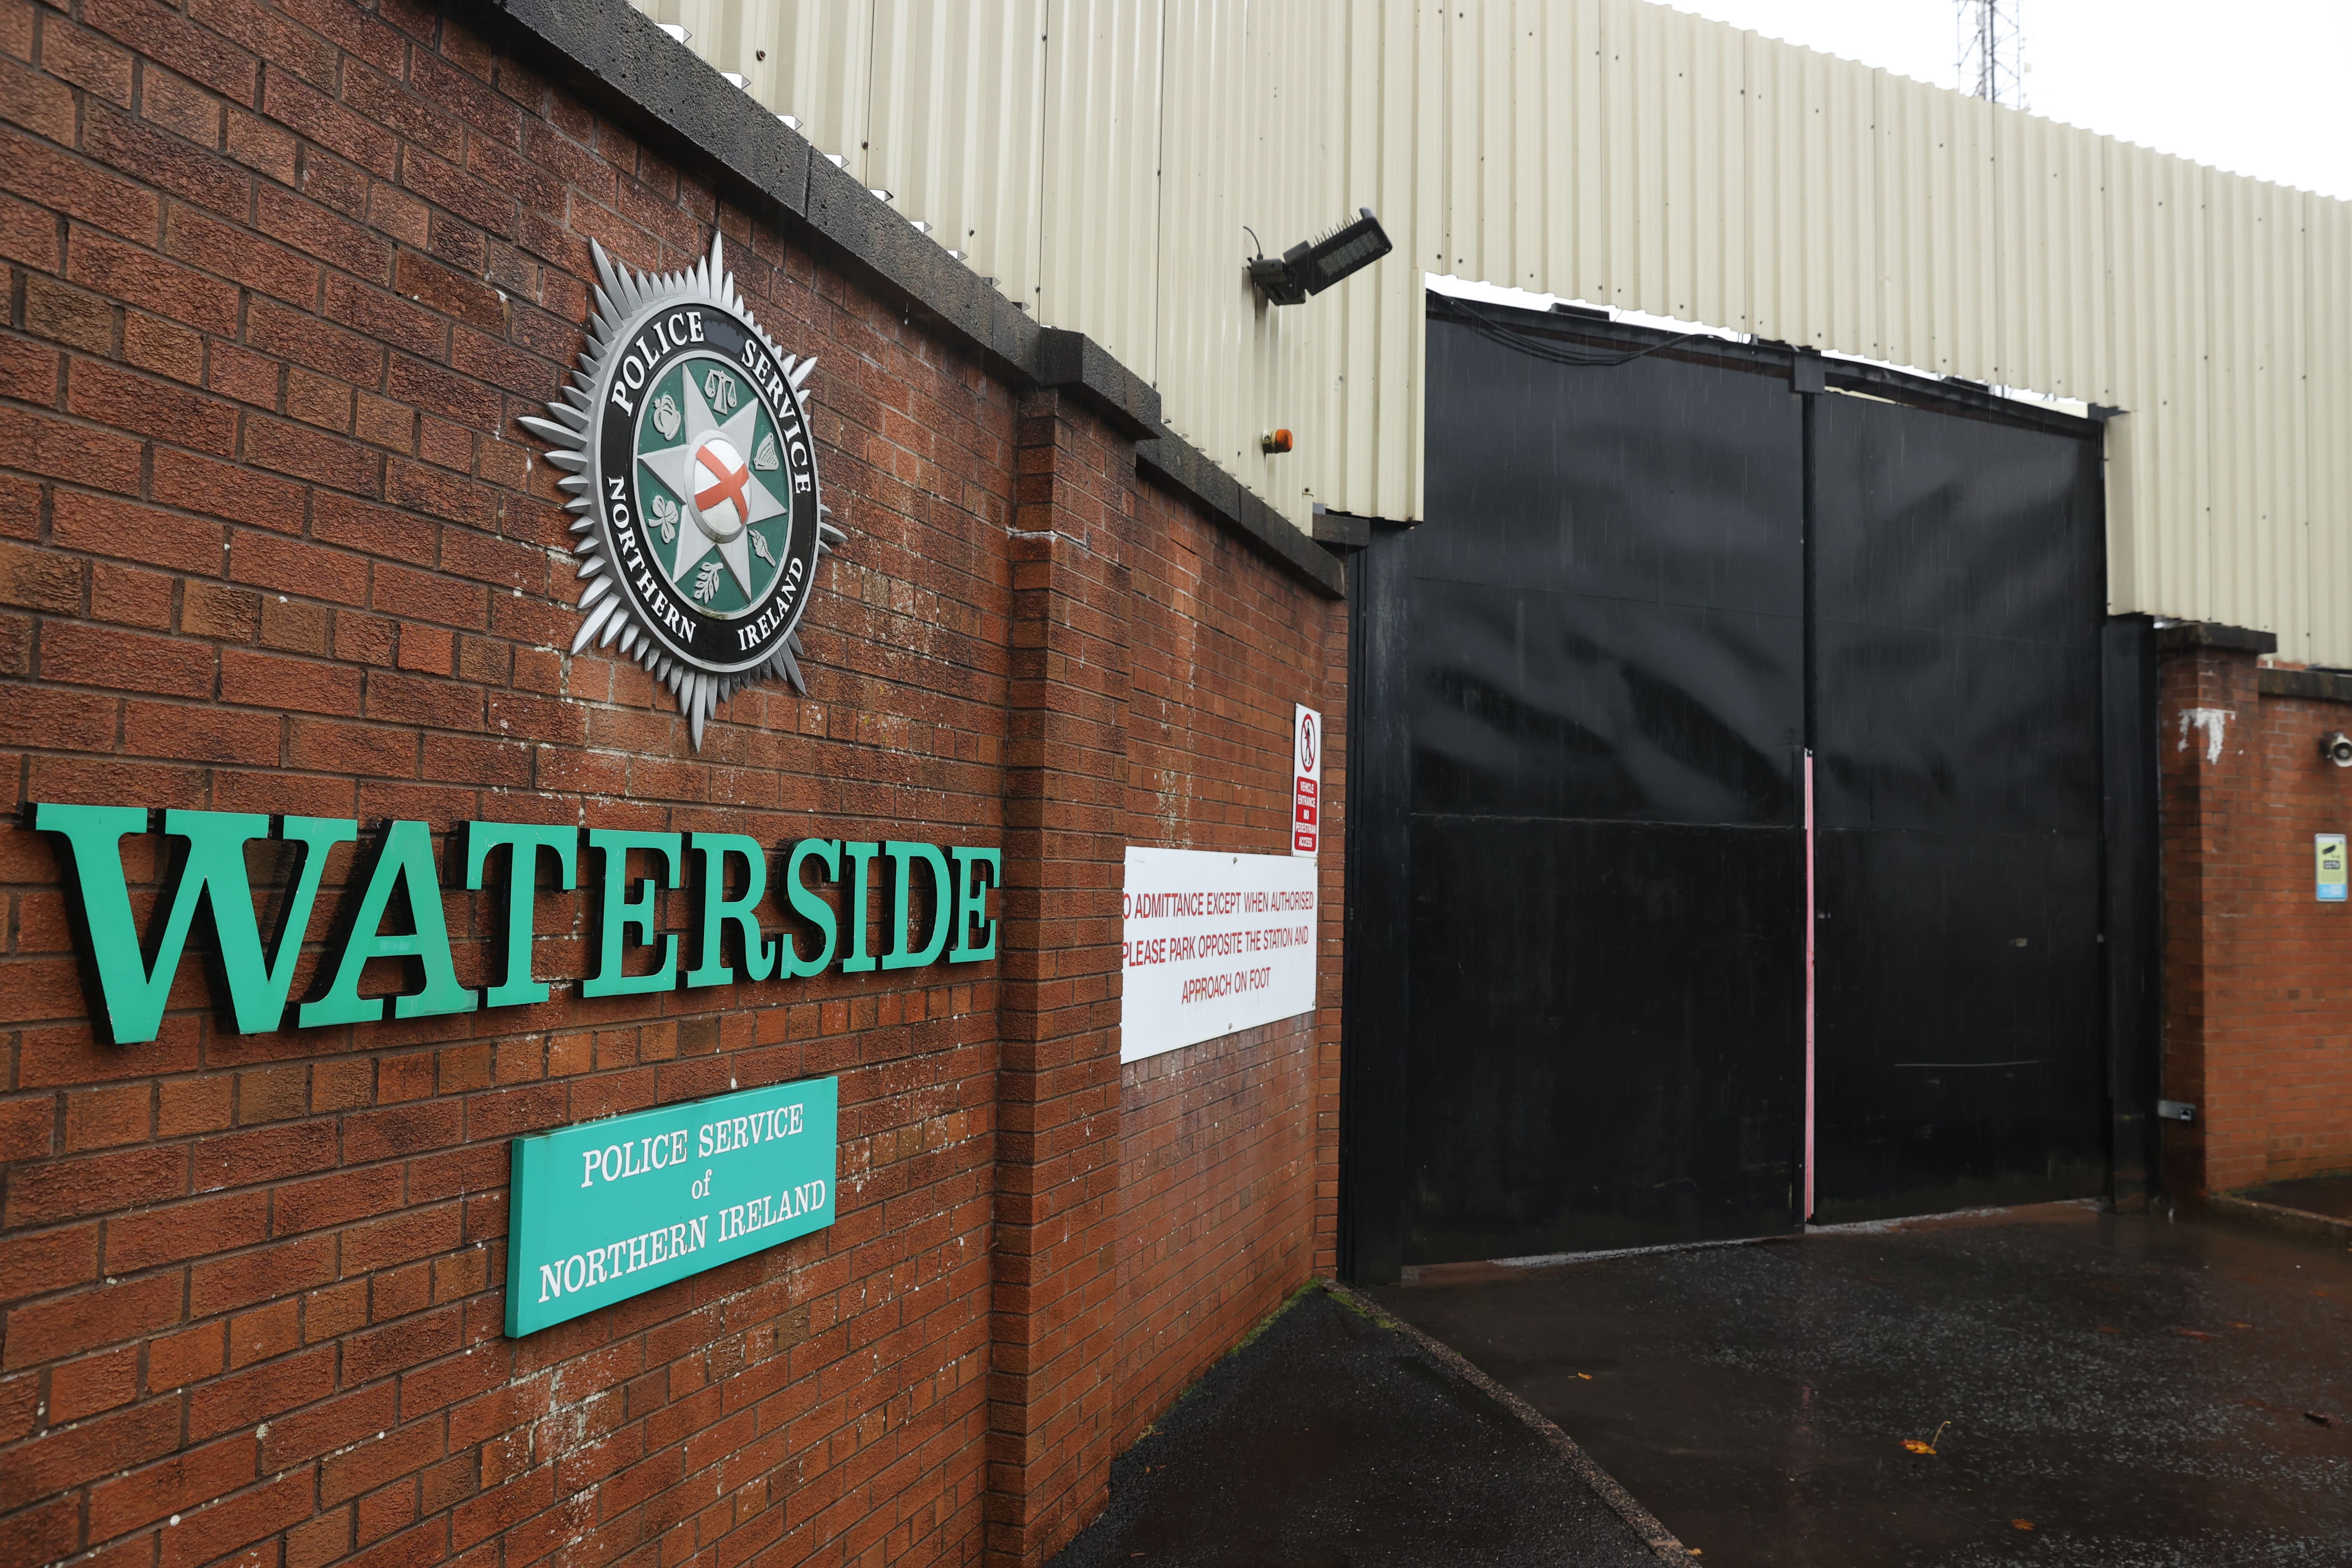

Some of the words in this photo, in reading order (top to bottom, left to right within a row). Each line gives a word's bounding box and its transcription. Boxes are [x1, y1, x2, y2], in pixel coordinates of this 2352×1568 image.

[611, 311, 704, 417] POLICE
[741, 339, 811, 493] SERVICE
[608, 476, 697, 644] NORTHERN
[736, 557, 803, 651] IRELAND
[1298, 794, 1316, 808] ENTRANCE
[1300, 781, 1314, 794] VEHICLE
[1295, 821, 1316, 835] PEDESTRIAN
[1303, 809, 1310, 820] NO
[1298, 836, 1313, 848] ACCESS
[1134, 892, 1204, 919] ADMITTANCE
[1207, 892, 1241, 915] EXCEPT
[1244, 891, 1268, 913] WHEN
[1271, 891, 1314, 912] AUTHORISED
[34, 802, 1001, 1044] WATERSIDE
[1122, 938, 1166, 967] PLEASE
[1170, 936, 1196, 962] PARK
[1198, 932, 1242, 959] OPPOSITE
[1245, 930, 1261, 952] THE
[1263, 927, 1293, 950] STATION
[1294, 925, 1309, 946] AND
[1182, 973, 1231, 1004] APPROACH
[1234, 971, 1247, 993] ON
[1250, 967, 1271, 991] FOOT
[581, 1129, 688, 1188] POLICE
[698, 1103, 804, 1159] SERVICE
[691, 1169, 712, 1200] of
[538, 1215, 708, 1304] NORTHERN
[718, 1179, 826, 1243] IRELAND
